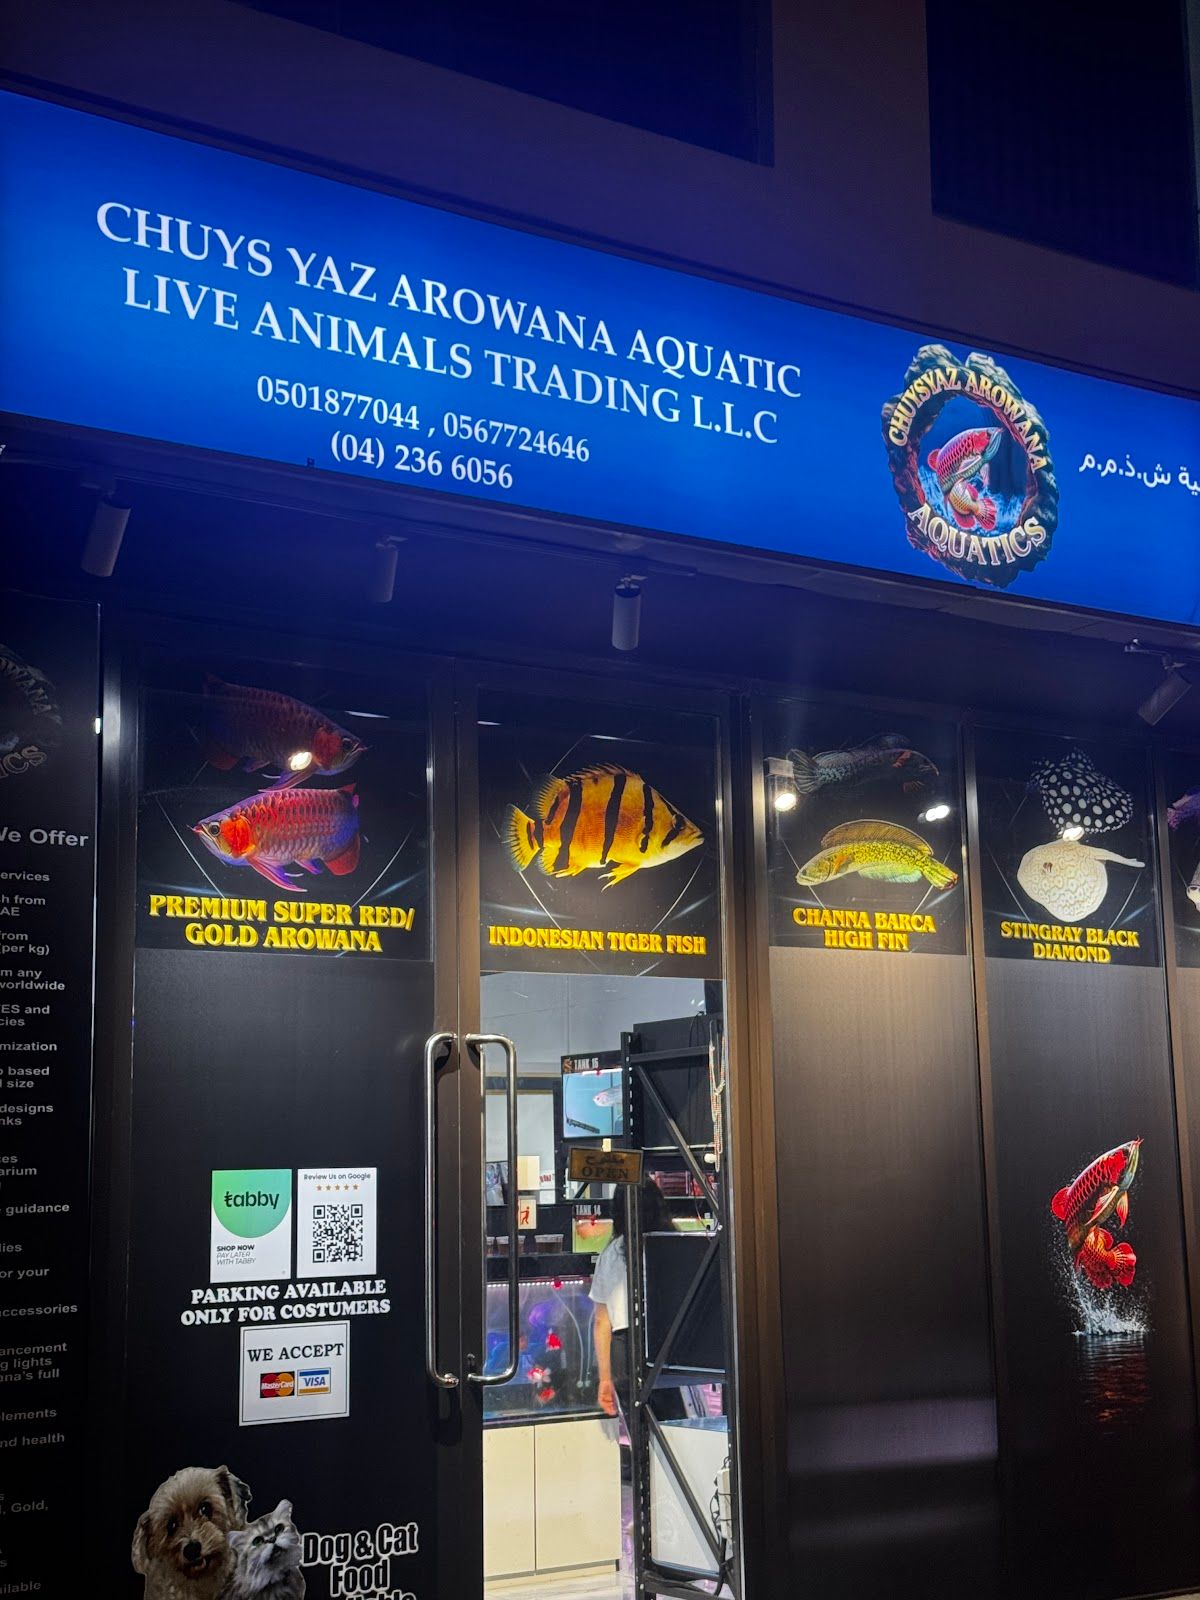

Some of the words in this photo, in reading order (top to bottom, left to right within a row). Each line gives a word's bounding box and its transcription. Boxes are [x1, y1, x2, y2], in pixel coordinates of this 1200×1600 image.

[96, 202, 273, 278] CHUYS
[286, 247, 377, 302] YAZ
[388, 274, 617, 356] AROWANA
[626, 329, 801, 398] AQUATIC
[123, 267, 239, 330] LIVE
[251, 302, 472, 379] ANIMALS
[484, 349, 680, 423] TRADING
[691, 394, 777, 444] L.L.C
[257, 374, 420, 431] 0501877044
[443, 411, 590, 462] 0567724646
[965, 369, 1048, 473] AROWANA
[331, 431, 386, 470] (04)
[394, 443, 442, 477] 236
[451, 453, 514, 490] 6056
[908, 503, 1047, 566] AQUATICS
[29, 829, 88, 847] Offer
[14, 895, 46, 905] from
[149, 894, 267, 921] PREMIUM
[273, 900, 352, 924] SUPER
[359, 905, 415, 931] RED/
[792, 907, 872, 930] CHANNA
[874, 912, 936, 933] BARCA
[0, 931, 29, 941] rom
[185, 922, 258, 947] GOLD
[263, 926, 383, 952] AROWANA
[488, 925, 605, 950] INDONESIAN
[607, 931, 664, 953] TIGER
[666, 935, 707, 955] FISH
[824, 929, 873, 950] HIGH
[877, 932, 910, 951] FIN
[1000, 921, 1084, 943] STINGRAY
[1086, 927, 1140, 948] BLACK
[28, 944, 50, 955] kg)
[1033, 942, 1112, 964] DIAMOND
[17, 969, 42, 979] any
[24, 1005, 50, 1014] and
[8, 1066, 50, 1076] based
[574, 1058, 590, 1070] TANK
[6, 1079, 34, 1088] size
[303, 1173, 328, 1181] Review
[348, 1172, 371, 1181] Google
[582, 1166, 629, 1179] OPEN
[224, 1190, 280, 1210] tabby
[6, 1203, 70, 1216] guidance
[17, 1268, 49, 1279] your
[191, 1284, 280, 1304] PARKING
[283, 1279, 387, 1299] AVAILABLE
[0, 1303, 78, 1317] ccessories
[180, 1307, 234, 1326] ONLY
[238, 1305, 276, 1322] FOR
[280, 1299, 391, 1320] COSTUMERS
[247, 1348, 273, 1362] WE
[278, 1343, 344, 1361] ACCEPT
[13, 1357, 52, 1370] lights
[38, 1368, 60, 1379] full
[304, 1376, 326, 1387] VISA
[261, 1380, 294, 1390] MasterCard
[0, 1408, 57, 1421] lements
[22, 1433, 65, 1446] health
[302, 1532, 352, 1567] Dog
[353, 1530, 374, 1560] &
[376, 1522, 419, 1557] Cat
[330, 1557, 390, 1597] Food
